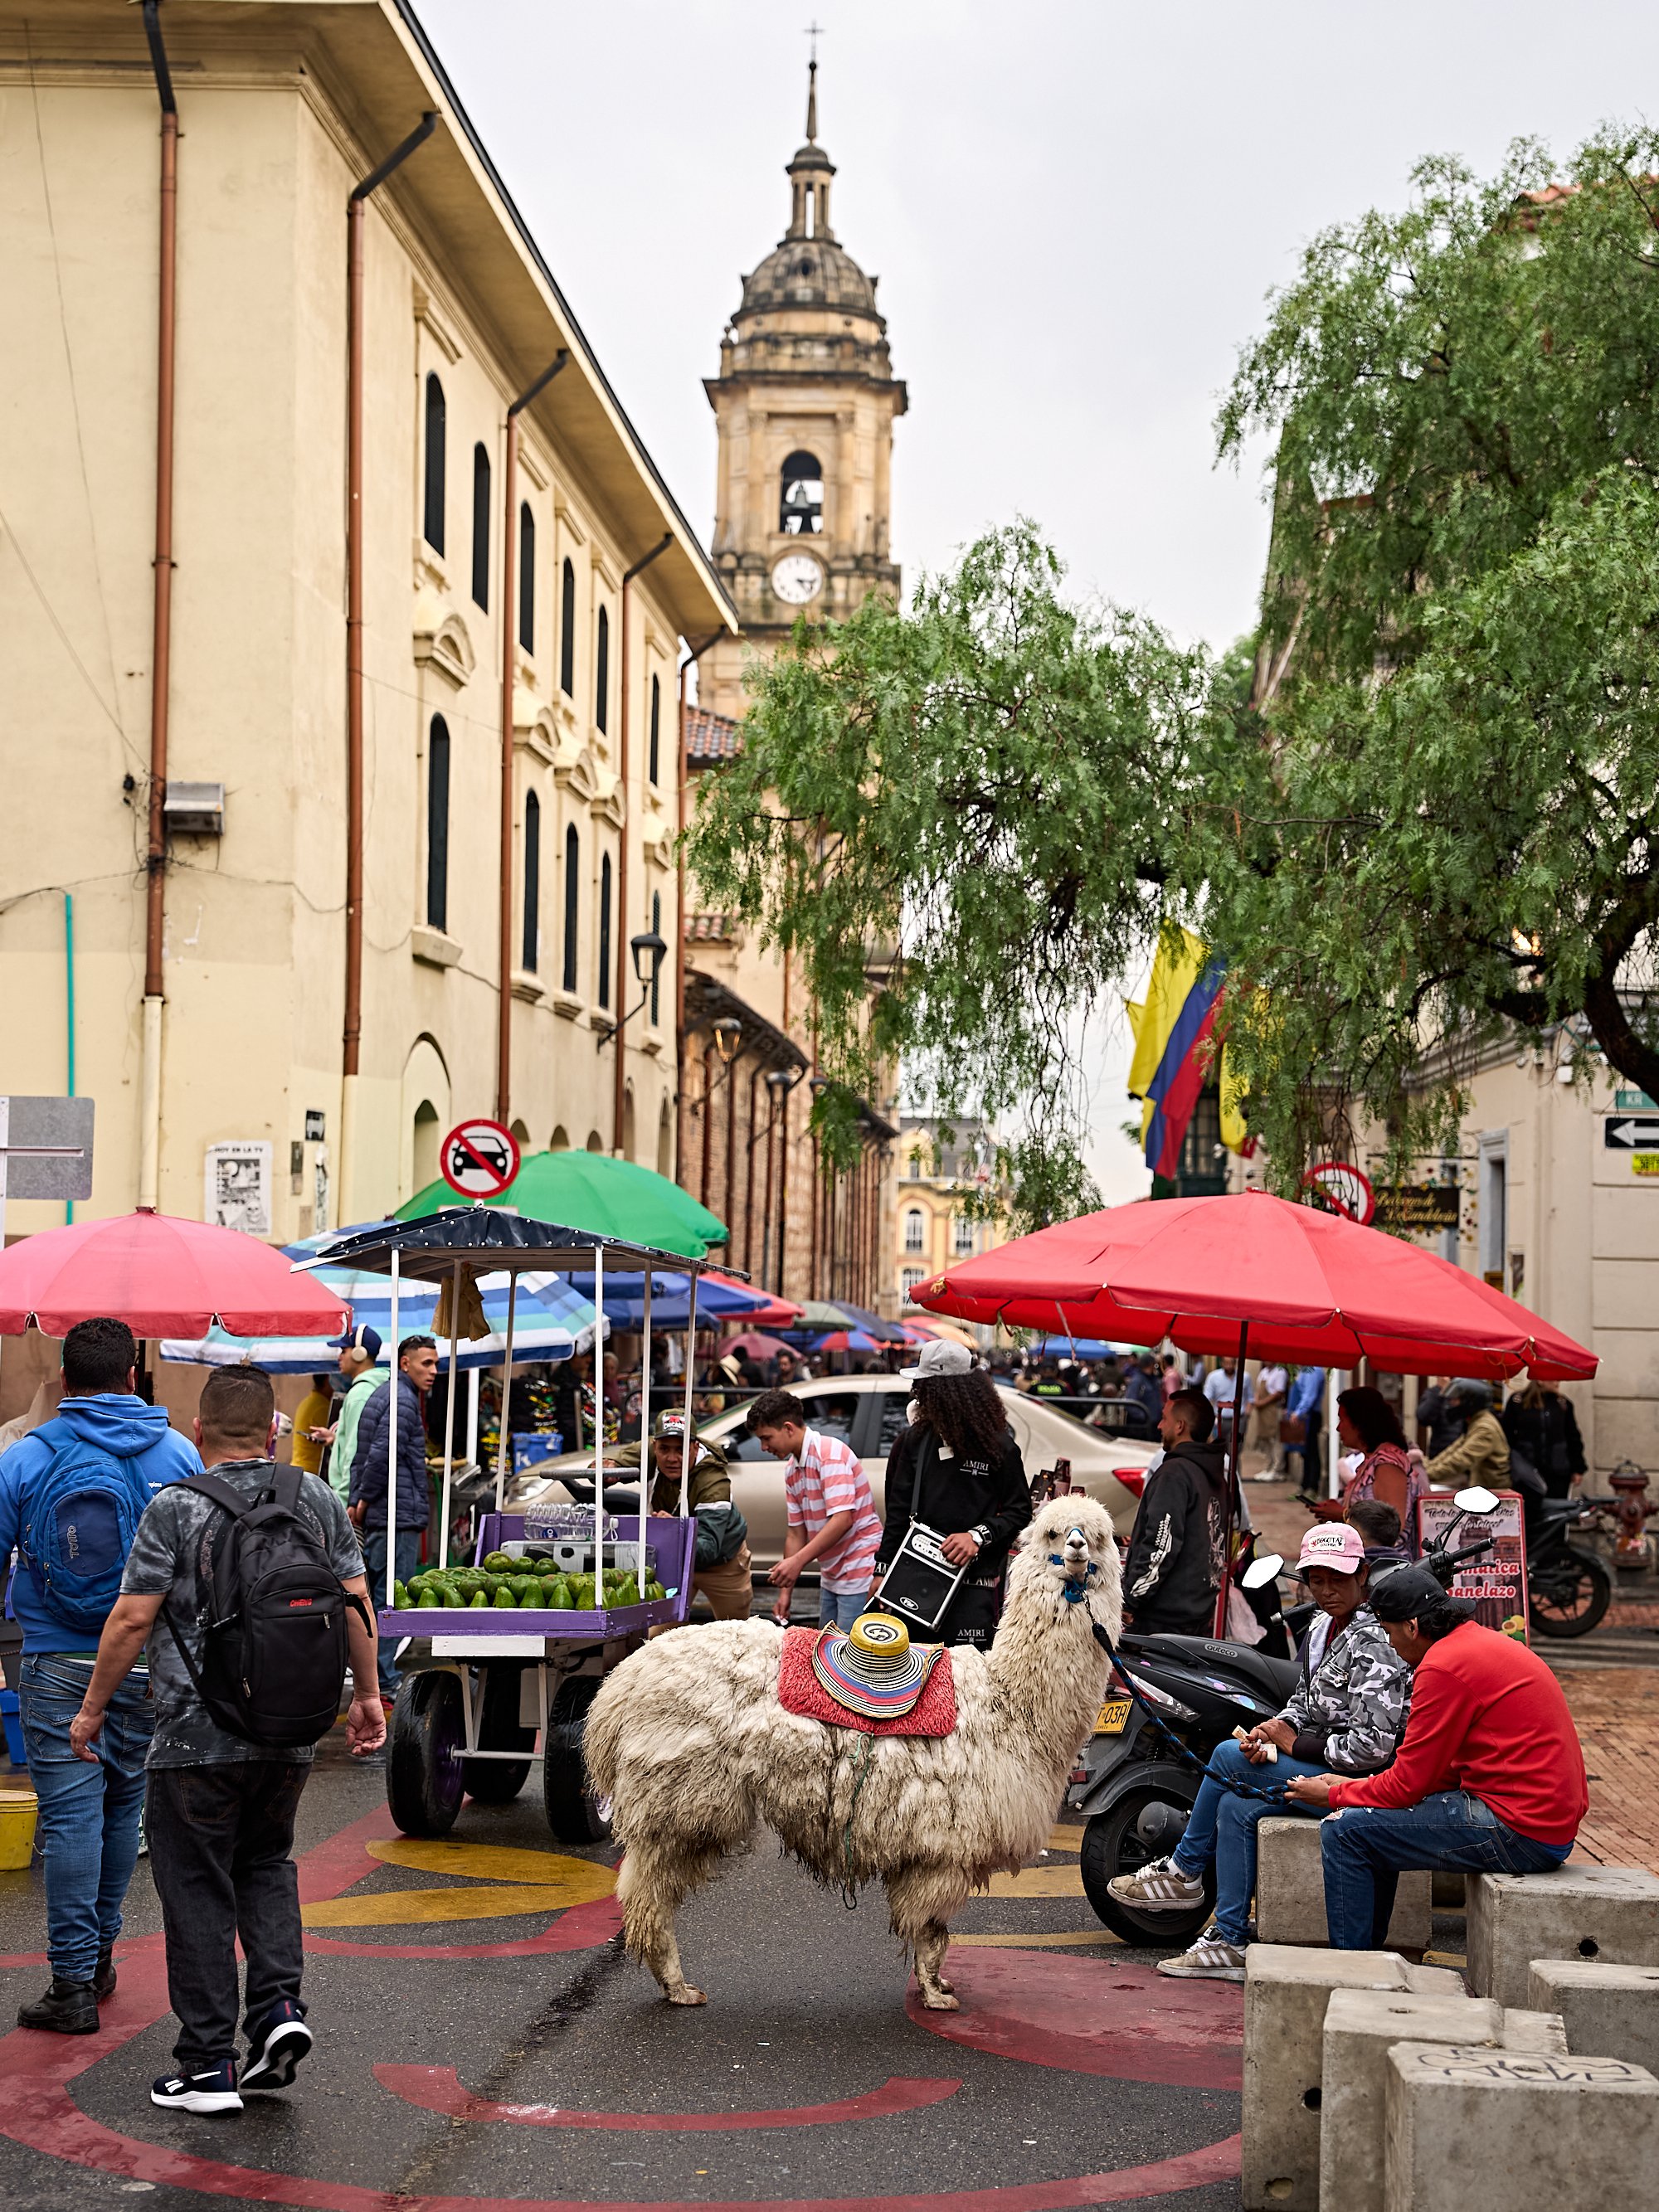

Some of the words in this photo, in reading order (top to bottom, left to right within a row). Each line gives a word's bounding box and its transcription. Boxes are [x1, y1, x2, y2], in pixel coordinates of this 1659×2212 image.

[962, 1459, 989, 1471] AMIRI
[957, 1629, 985, 1637] AMIRI
[1207, 1645, 1236, 1656] auteco
